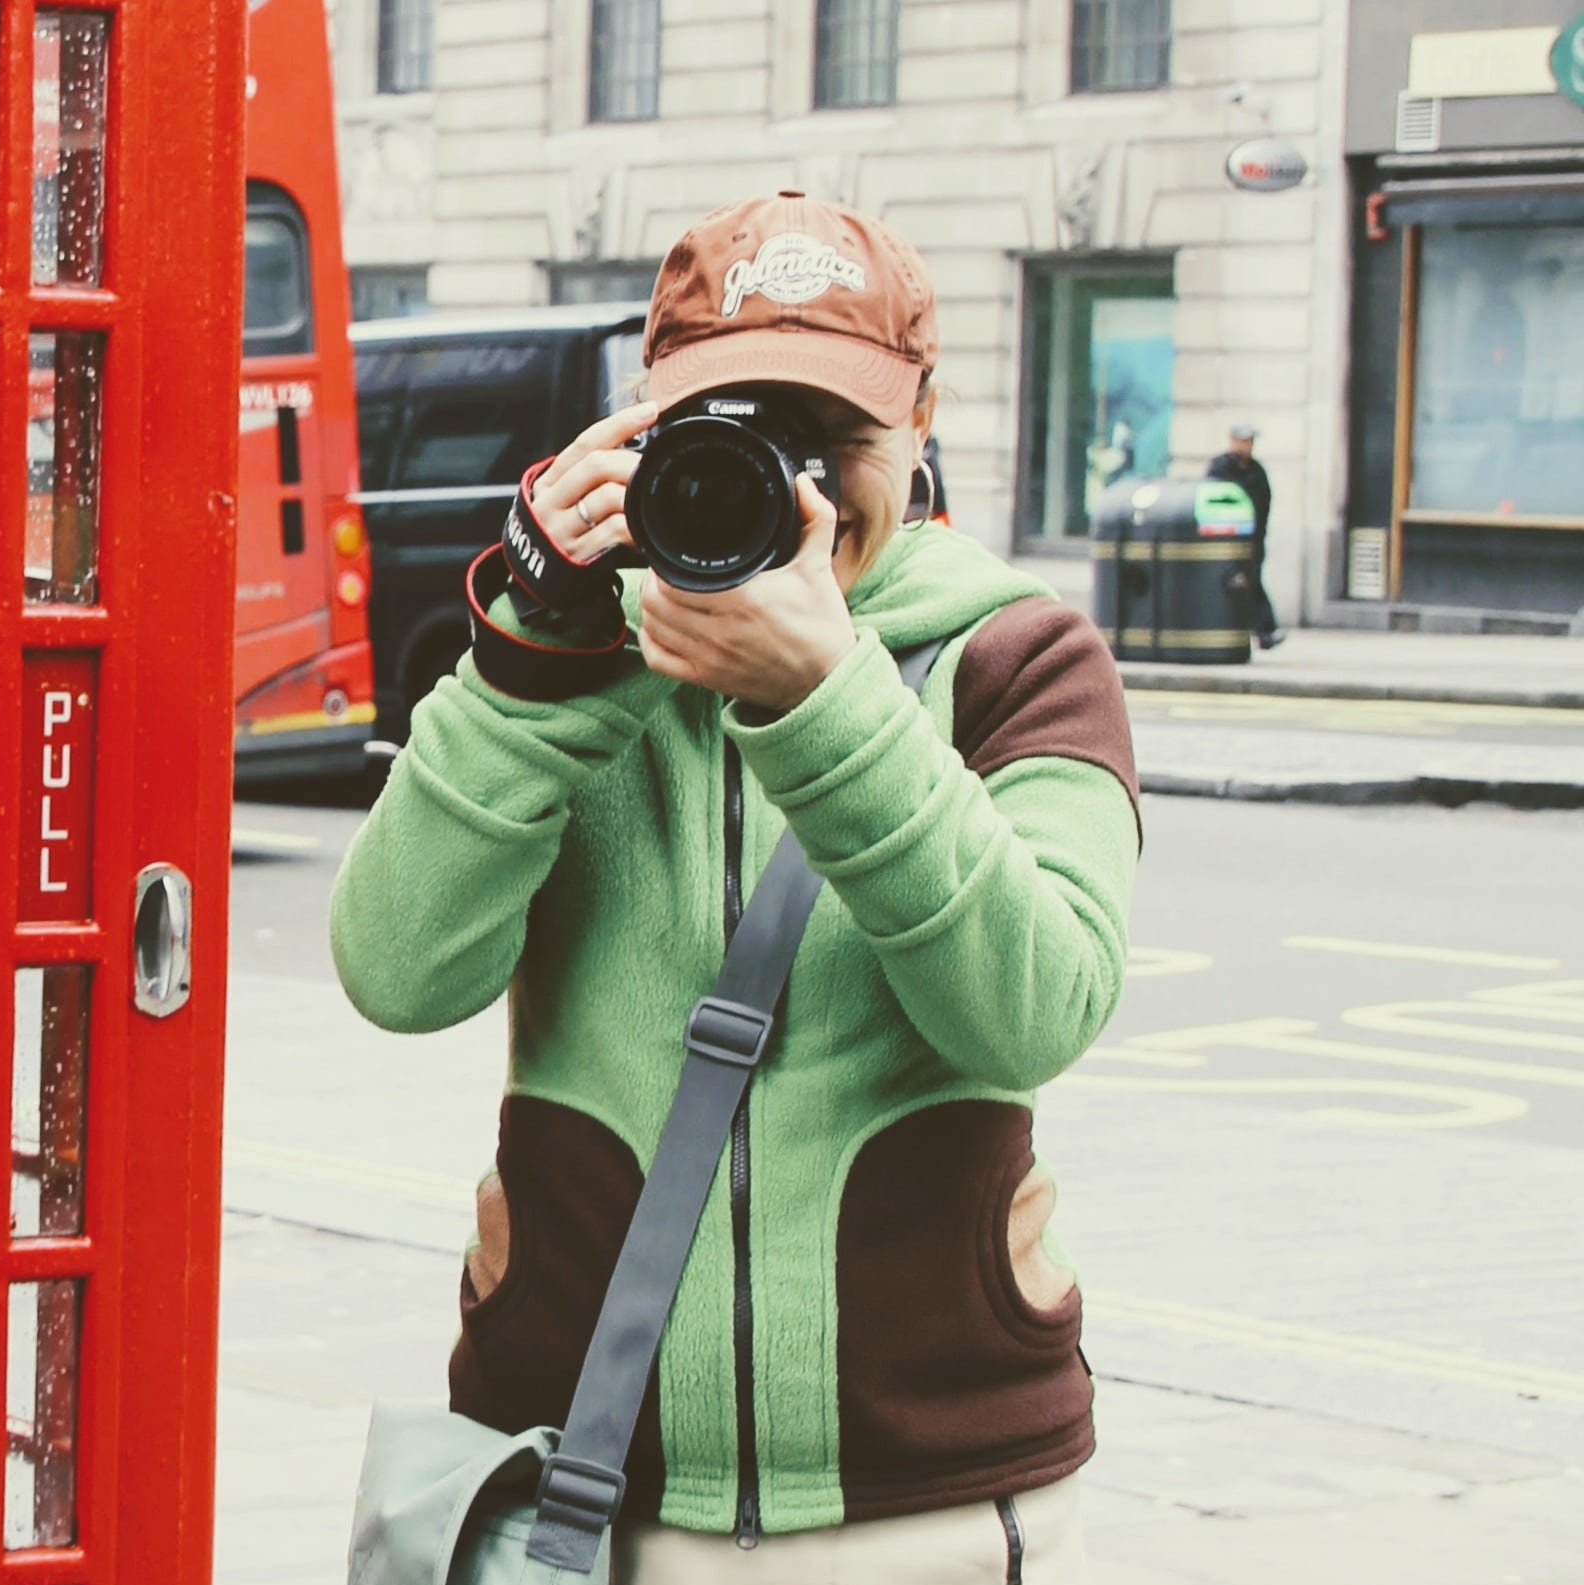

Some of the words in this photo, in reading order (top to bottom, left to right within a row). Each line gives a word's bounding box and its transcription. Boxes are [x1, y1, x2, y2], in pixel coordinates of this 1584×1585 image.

[708, 400, 756, 416] Canon
[507, 496, 546, 579] non
[40, 691, 72, 892] PULL
